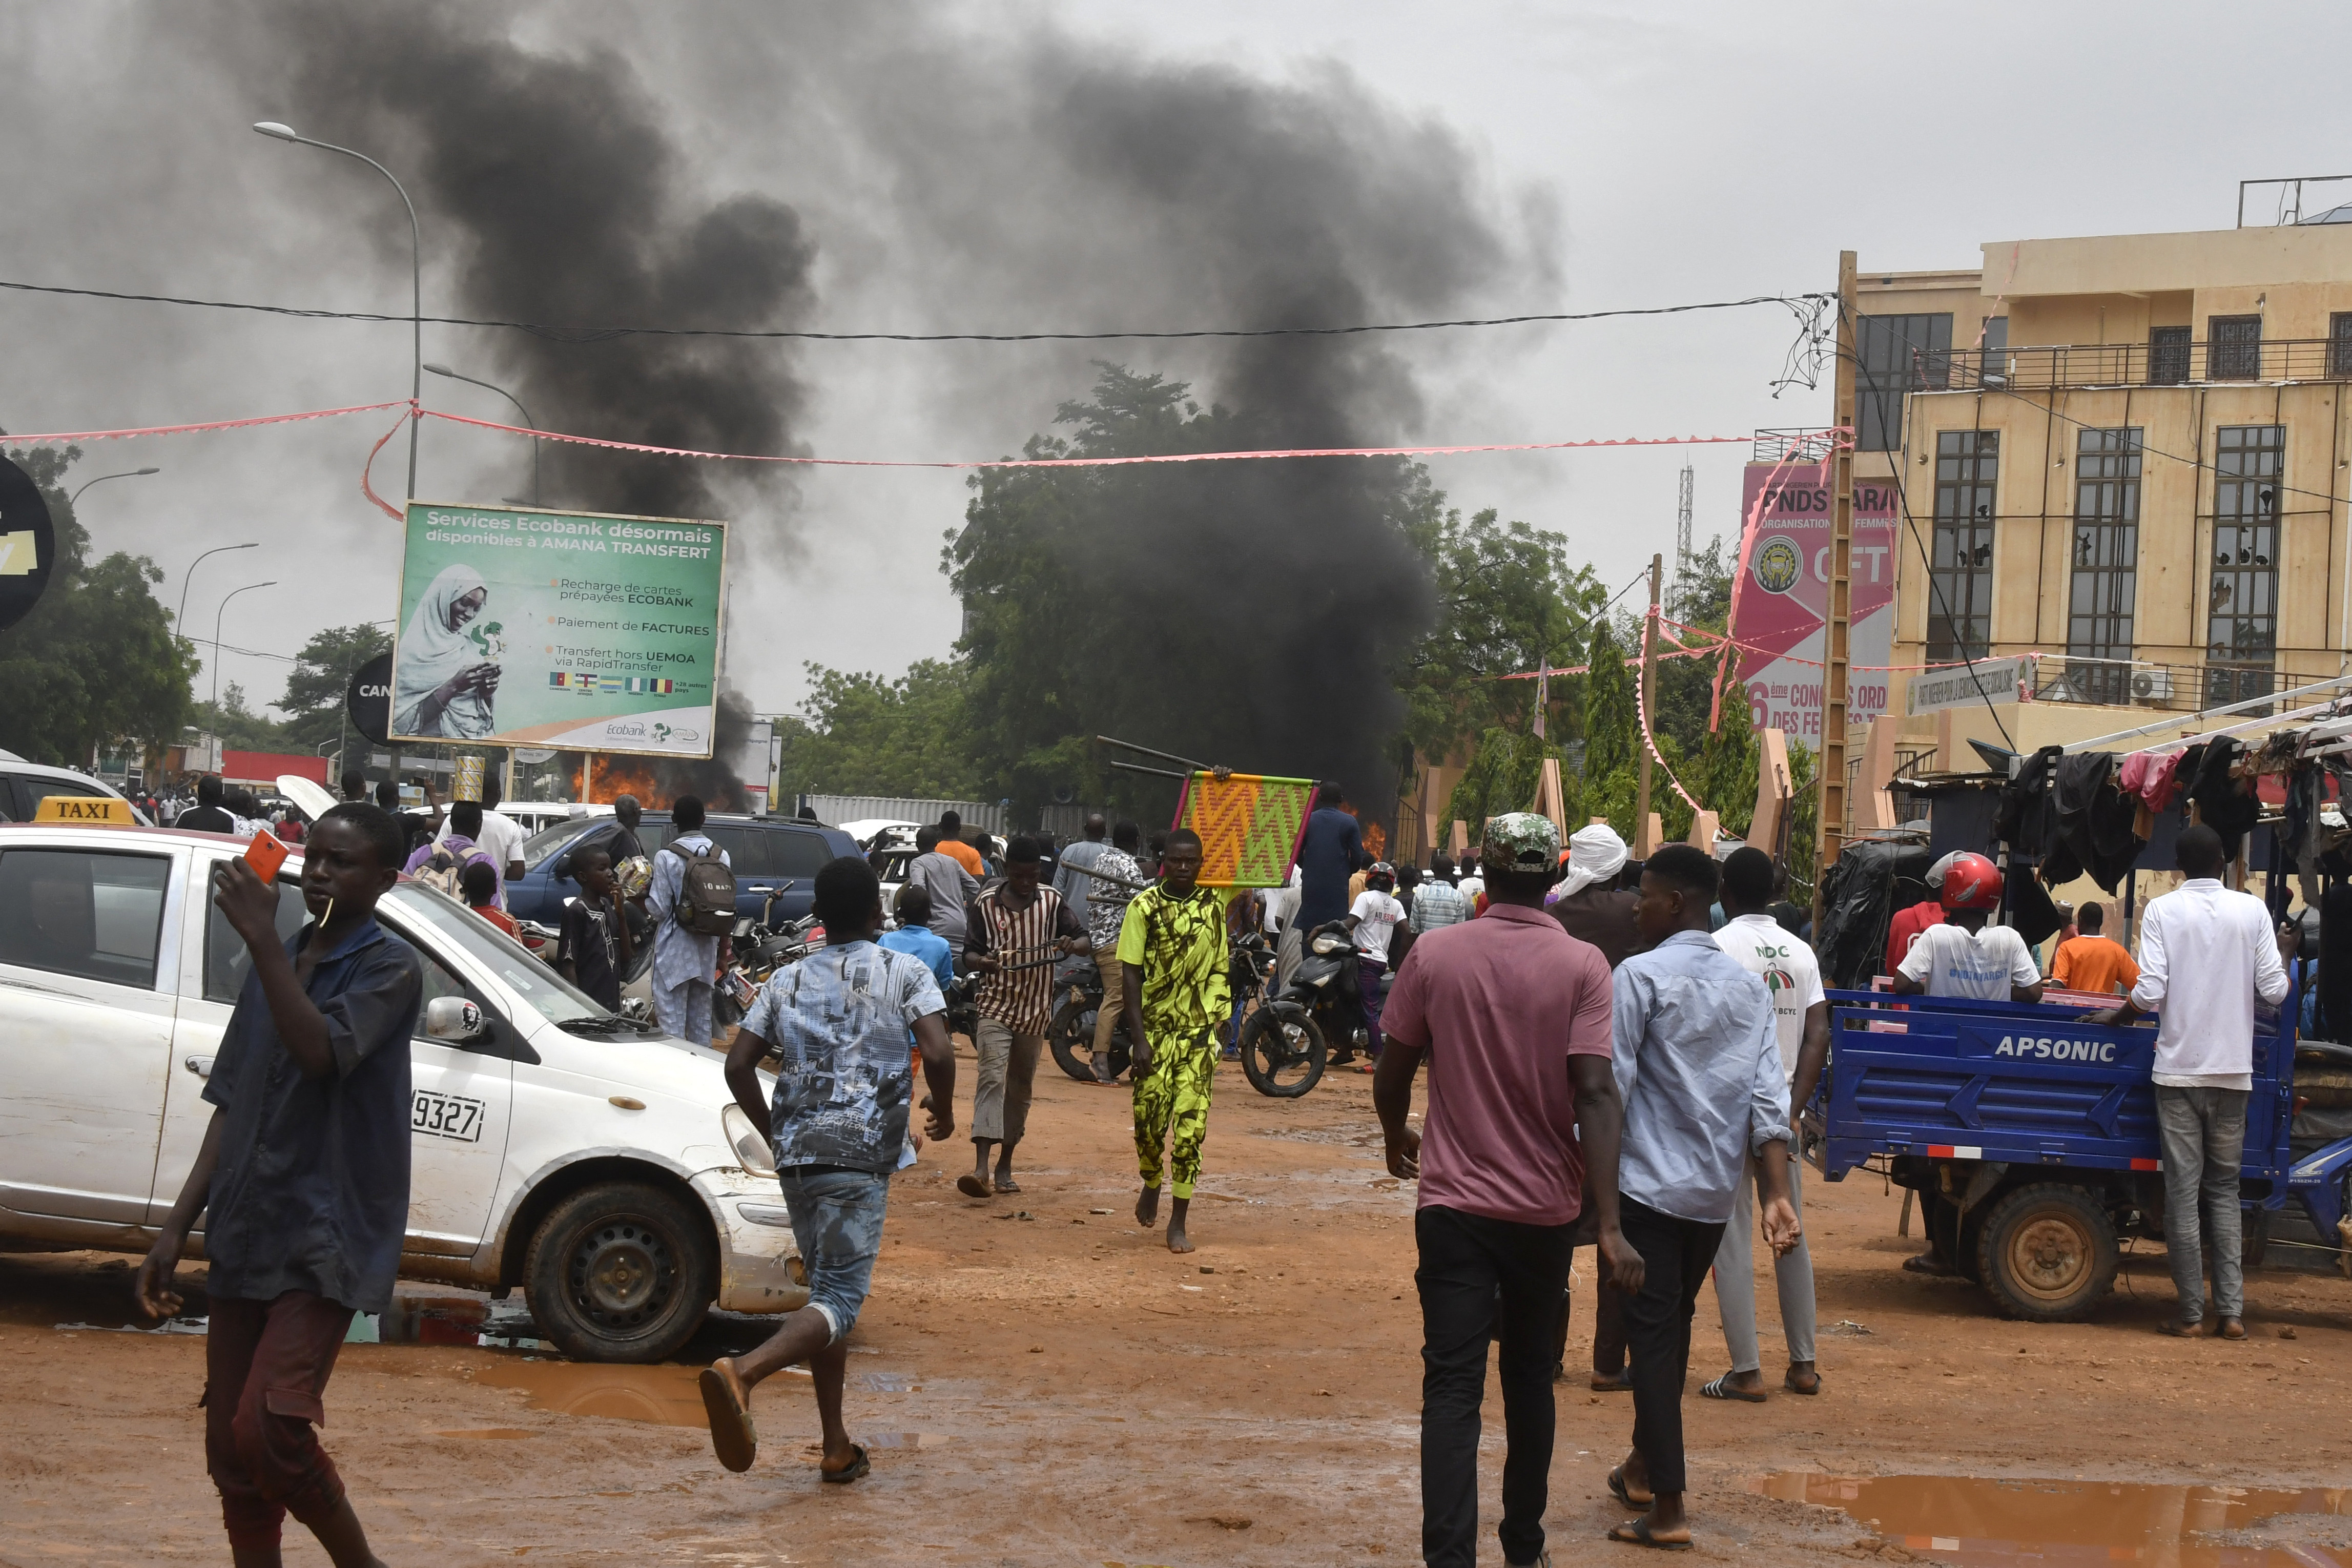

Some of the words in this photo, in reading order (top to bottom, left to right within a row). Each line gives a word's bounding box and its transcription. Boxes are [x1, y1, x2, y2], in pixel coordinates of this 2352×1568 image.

[1763, 490, 1827, 512] PNDS
[427, 511, 510, 530] Services
[517, 517, 603, 536] Ecobank
[609, 523, 712, 543] désormais
[1761, 519, 1830, 529] ORGANISATION
[426, 529, 522, 546] disponibles
[527, 535, 537, 547] à
[541, 538, 606, 552] AMANA
[611, 542, 711, 559] TRANSFERT
[561, 579, 621, 593] Recharge
[625, 583, 640, 592] de
[644, 585, 682, 595] cartes
[560, 591, 624, 603] prépayées
[628, 594, 693, 607] ECOBANK
[558, 616, 618, 630] Paiement
[622, 621, 638, 631] de
[642, 623, 709, 636] FACTURES
[556, 645, 611, 658] Transfert
[615, 649, 643, 660] hors
[646, 651, 695, 664] UEMOA
[555, 656, 572, 666] via
[577, 657, 663, 672] RapidTransfer
[607, 722, 647, 737] Ecobank
[57, 802, 110, 819] TAXI
[1755, 945, 1790, 958] NDC
[1995, 1036, 2116, 1062] APSONIC
[413, 1097, 478, 1134] 9327
